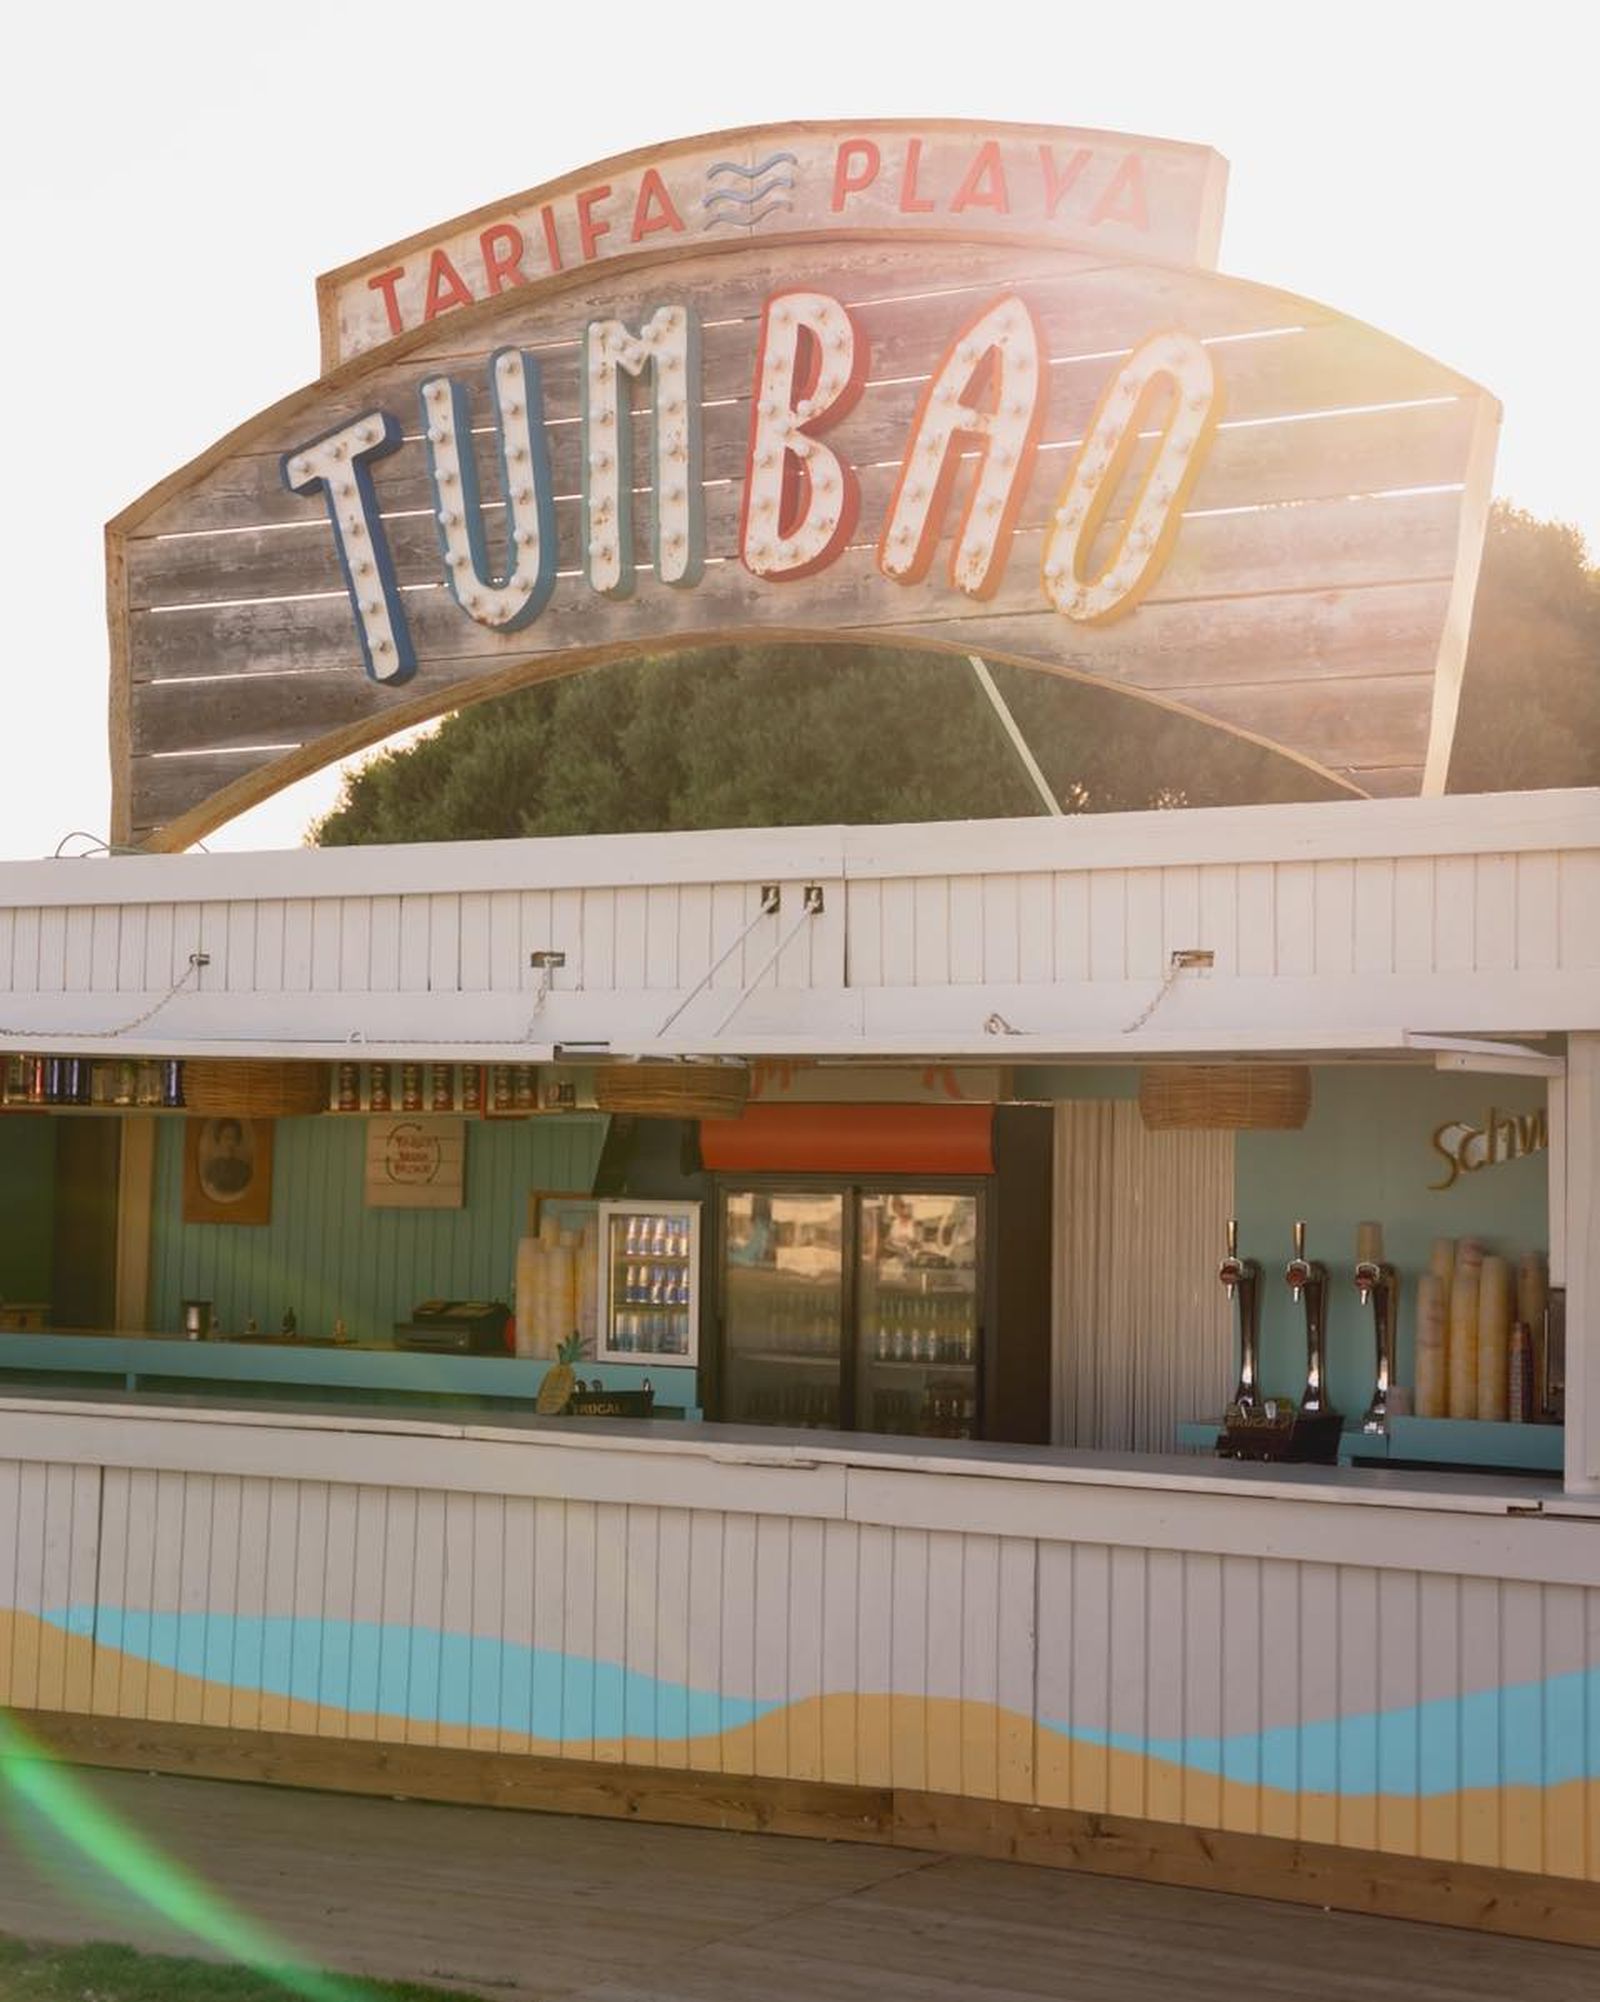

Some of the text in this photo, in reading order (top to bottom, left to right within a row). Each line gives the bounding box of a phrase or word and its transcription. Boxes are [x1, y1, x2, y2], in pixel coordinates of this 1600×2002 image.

[367, 138, 1150, 336] TARIFA PLAYA
[281, 290, 1225, 686] TUMBAO
